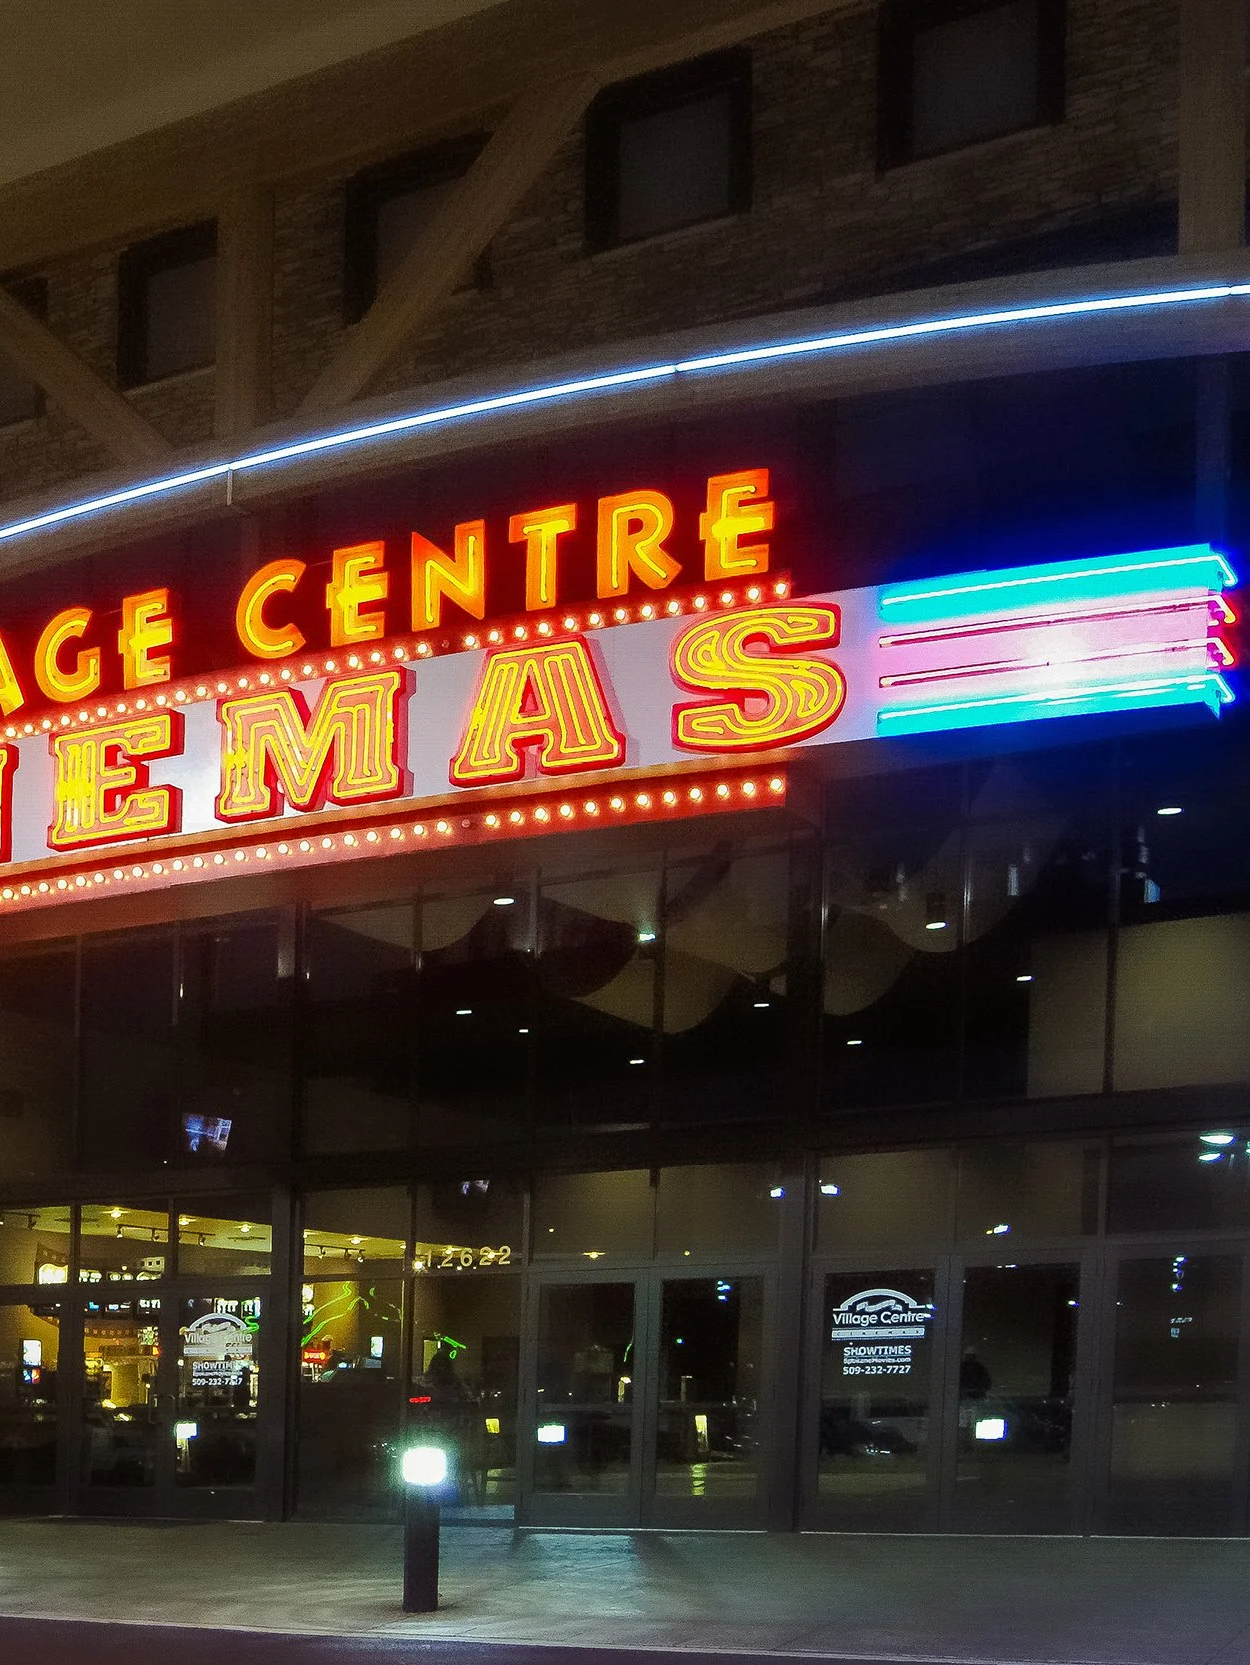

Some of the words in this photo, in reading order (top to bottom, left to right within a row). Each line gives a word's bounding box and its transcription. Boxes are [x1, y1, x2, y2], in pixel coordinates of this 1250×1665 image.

[236, 468, 775, 659] CENTRE
[426, 1245, 511, 1268] 12622
[832, 1313, 878, 1327] Village
[880, 1311, 925, 1324] Centre
[843, 1345, 912, 1356] SHOWTIMES
[192, 1361, 241, 1370] SHOWTIM
[842, 1365, 912, 1375] 509-232-7727
